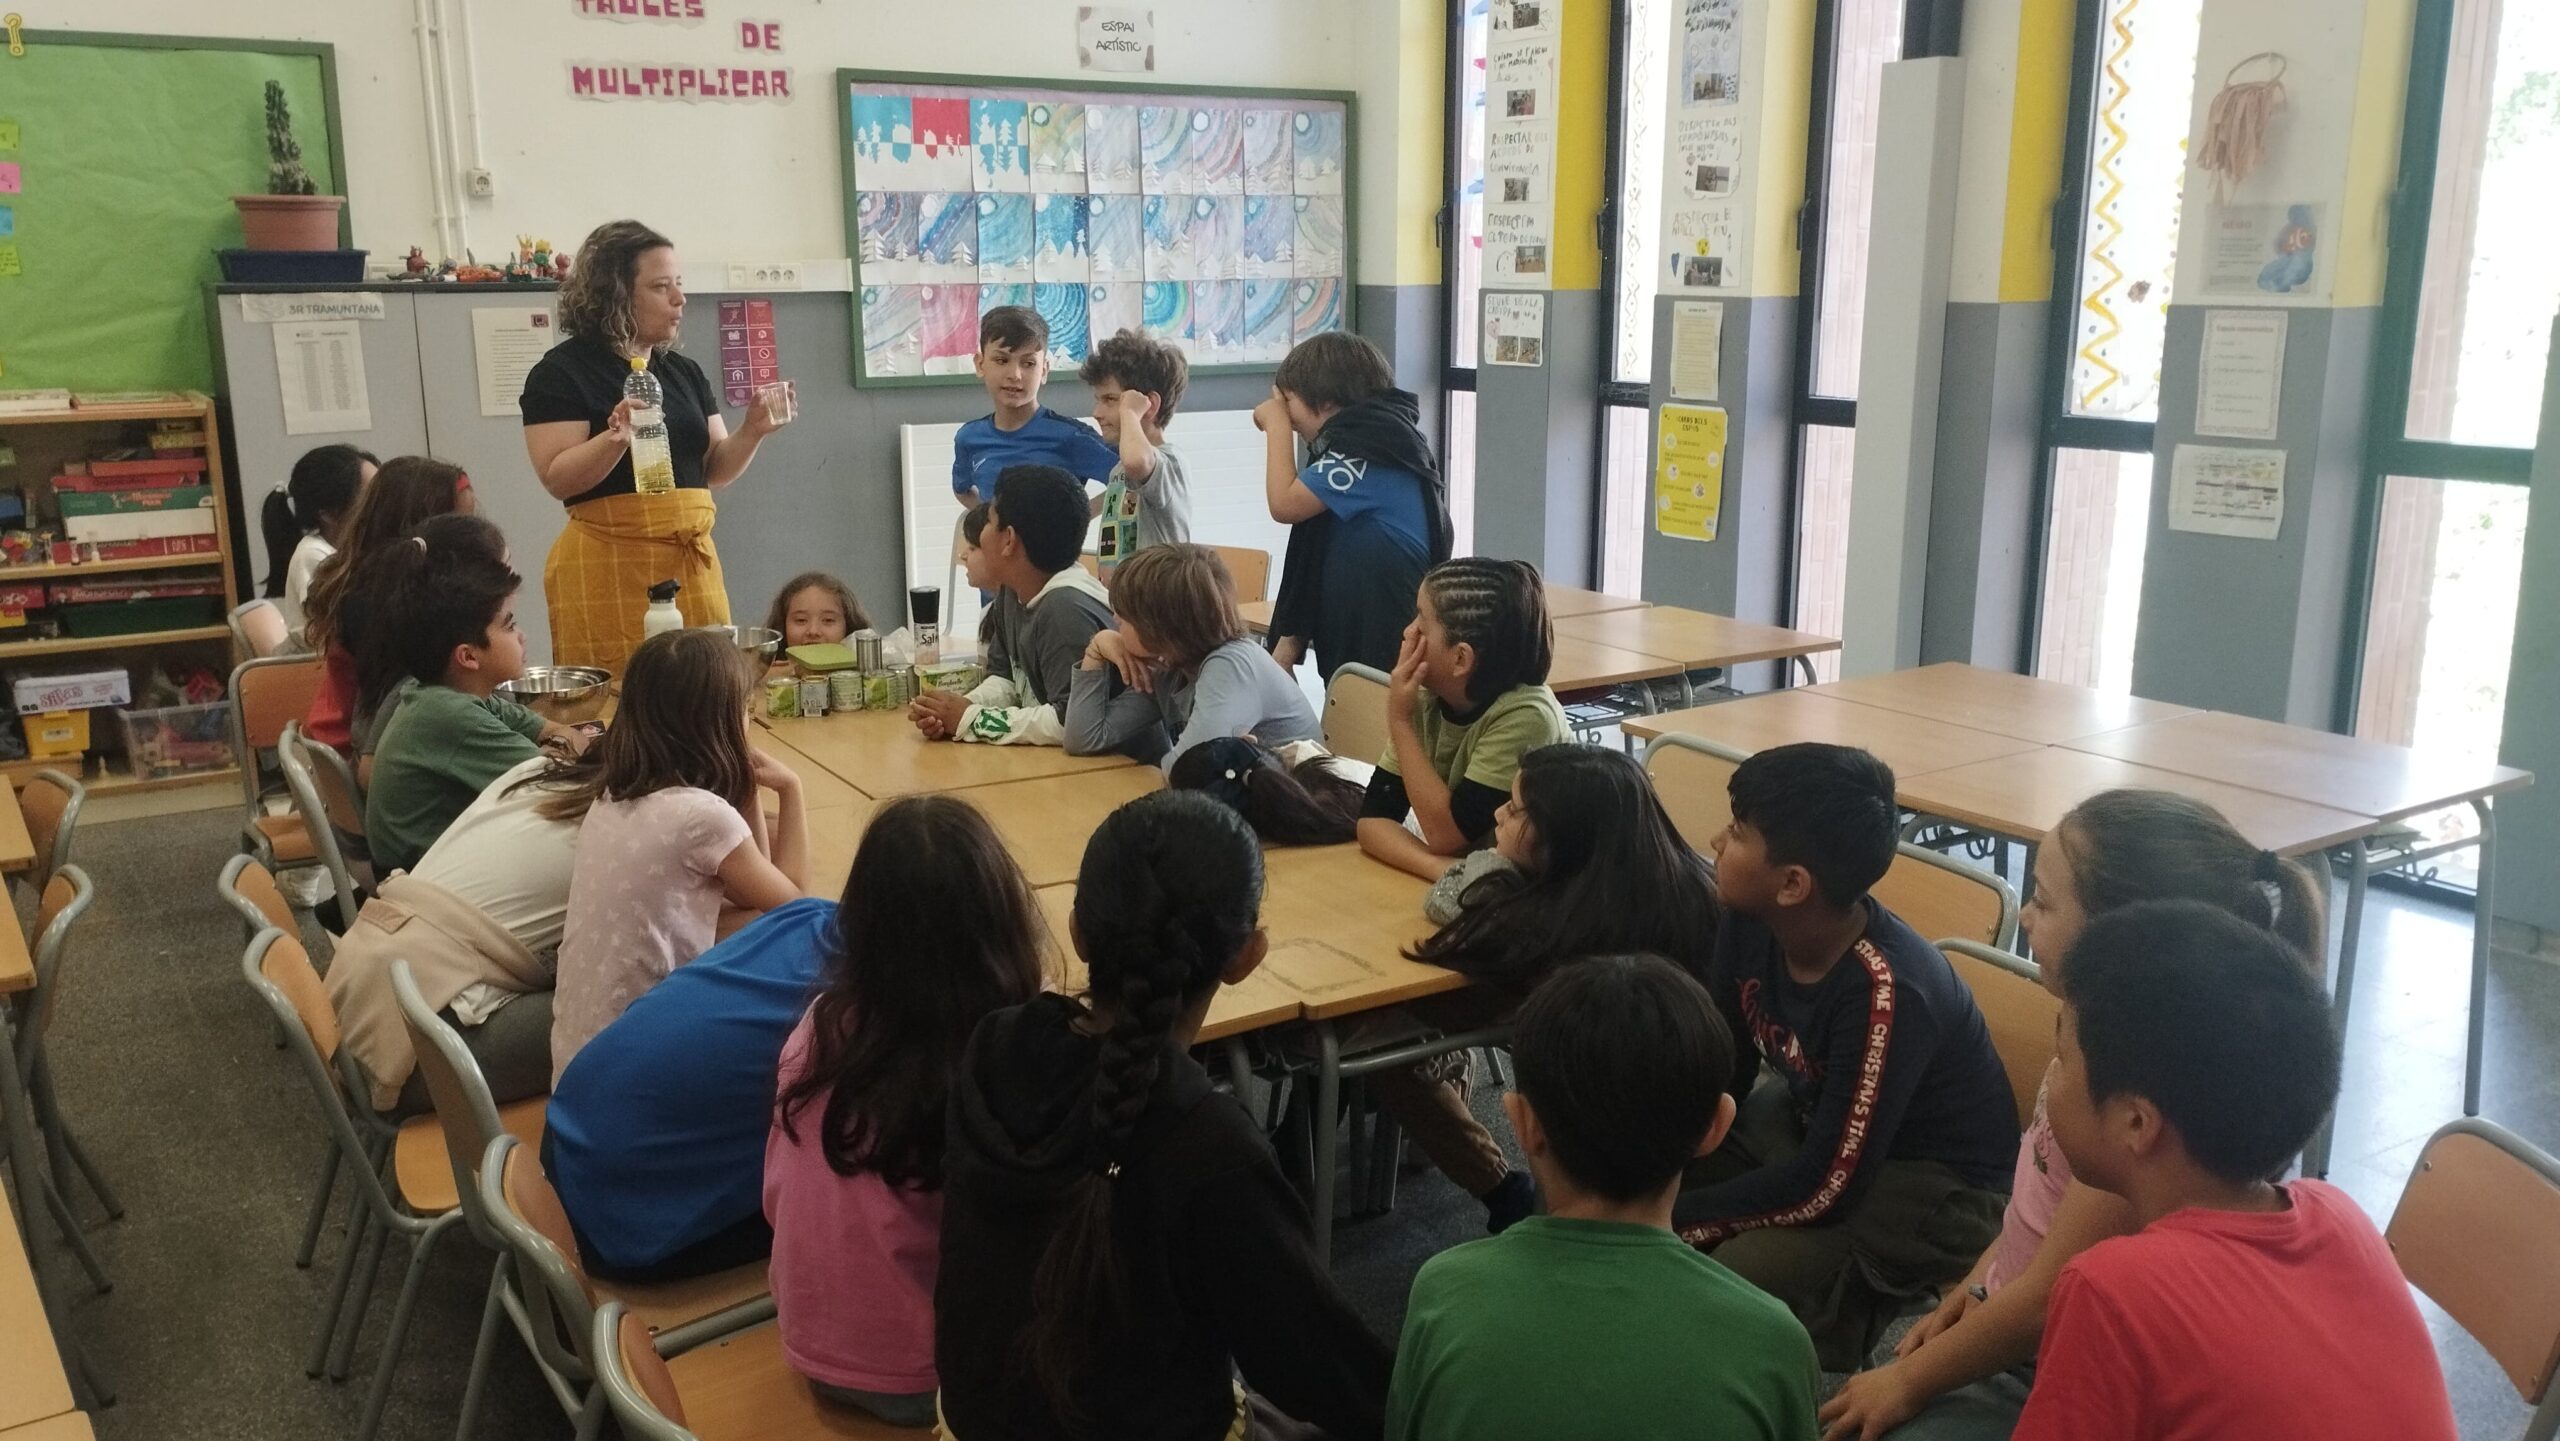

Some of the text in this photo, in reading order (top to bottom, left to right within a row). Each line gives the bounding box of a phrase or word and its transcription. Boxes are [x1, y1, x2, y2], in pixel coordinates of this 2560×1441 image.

[1101, 21, 1135, 33] ESPAI
[741, 22, 781, 50] DE
[1096, 37, 1142, 52] ARTÍSTIC
[572, 66, 790, 97] MULTIPLICAR
[288, 303, 381, 315] 3R TRAMUNTANA
